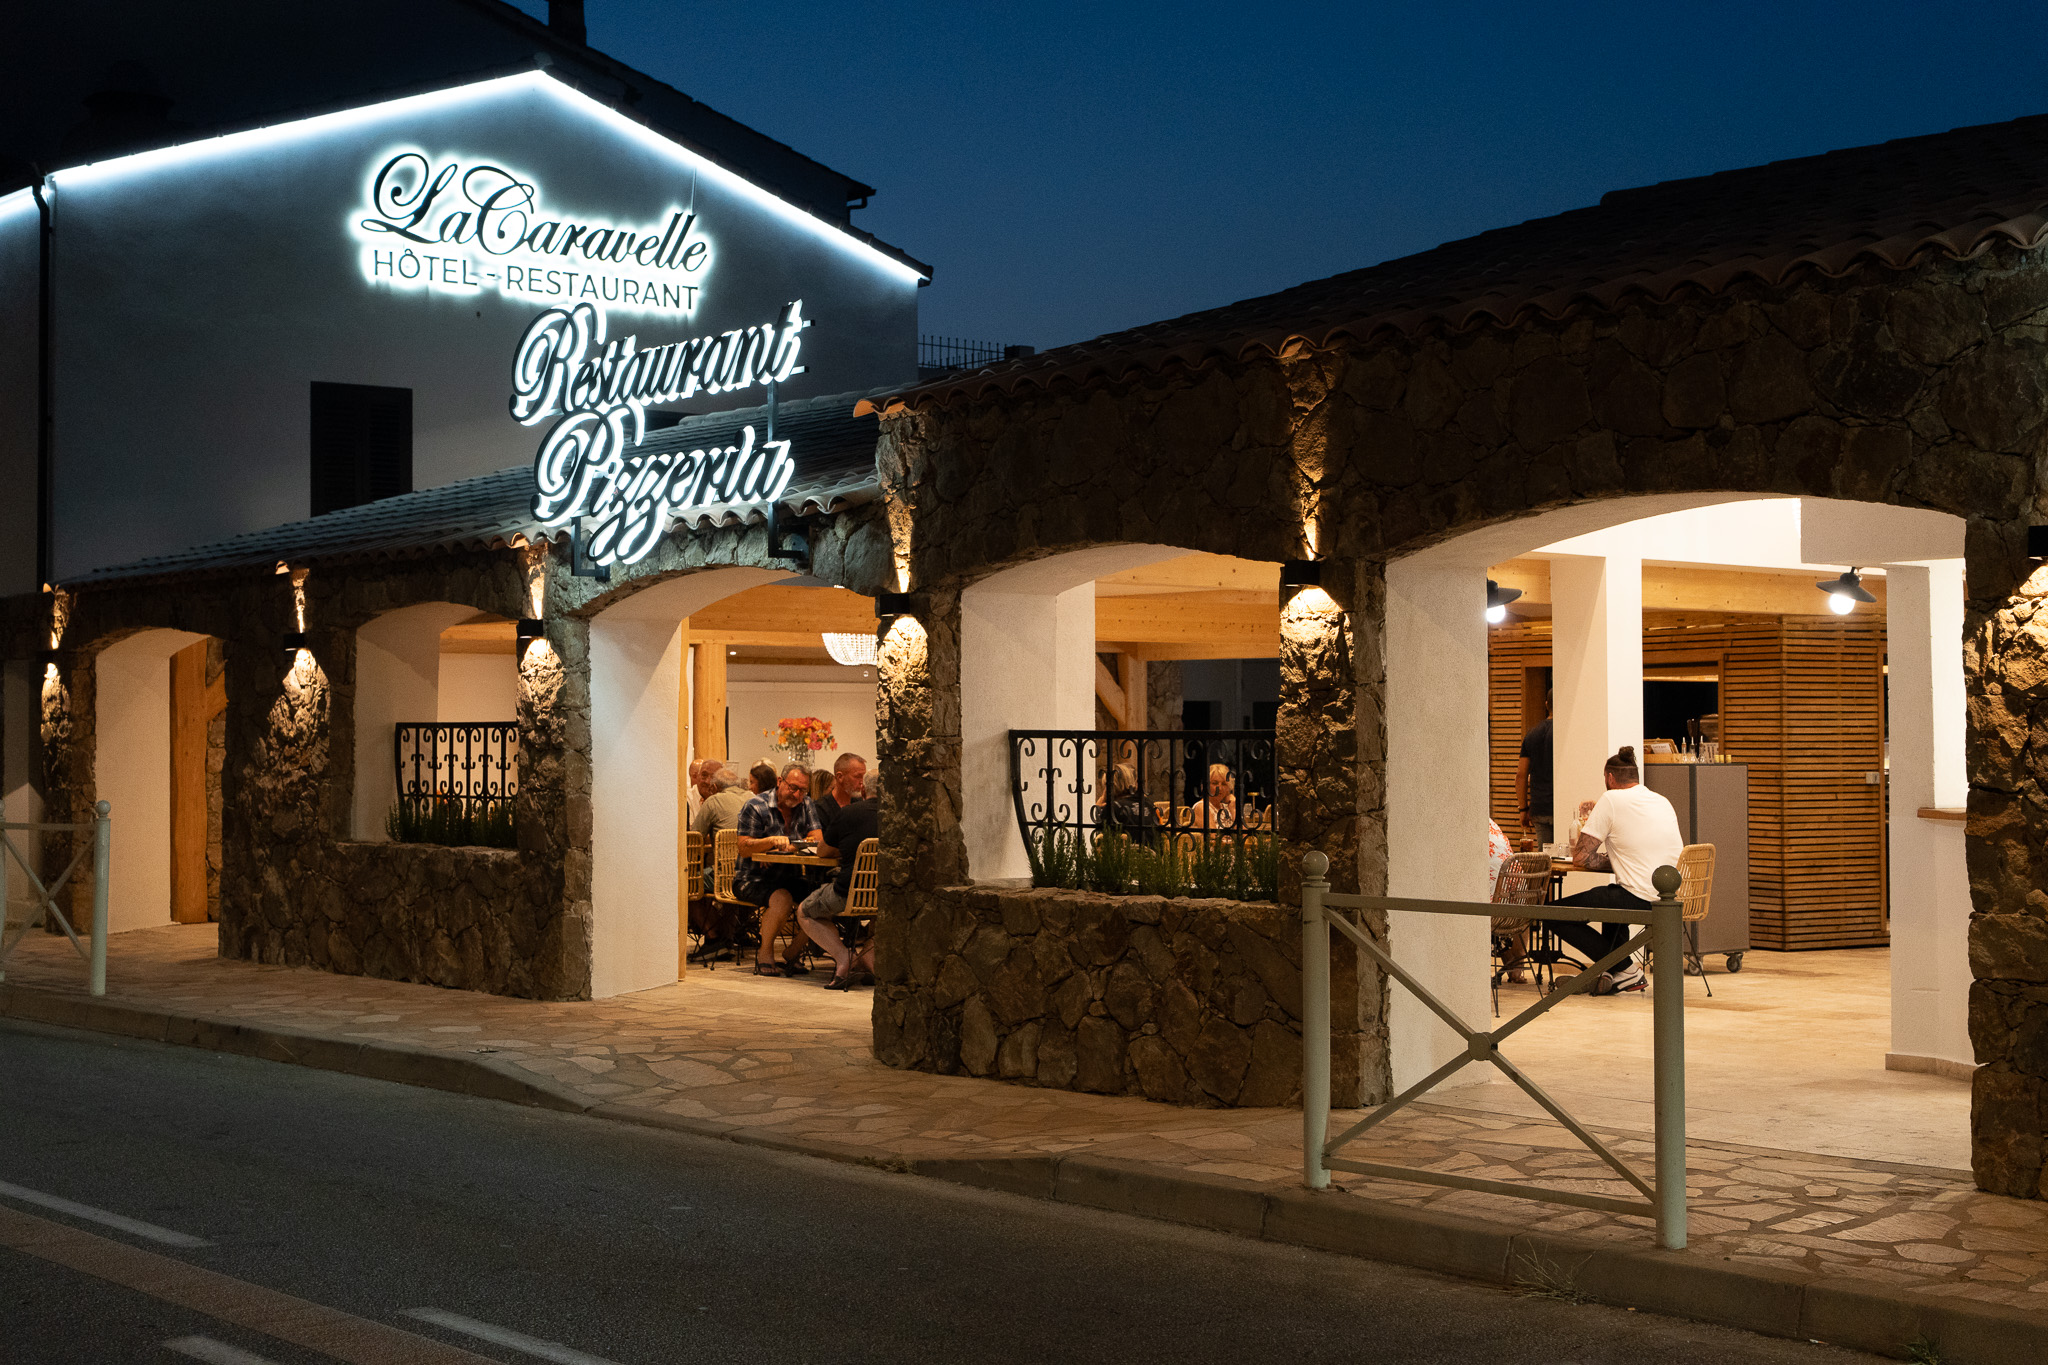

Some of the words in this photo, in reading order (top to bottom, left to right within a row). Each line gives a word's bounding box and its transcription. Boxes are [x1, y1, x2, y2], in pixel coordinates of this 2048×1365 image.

[462, 165, 707, 272] Caravelle
[374, 248, 478, 286] HÔTEL
[506, 265, 699, 309] RESTAURANT
[509, 299, 802, 426] Restaurant
[530, 402, 795, 566] Pizzeria
